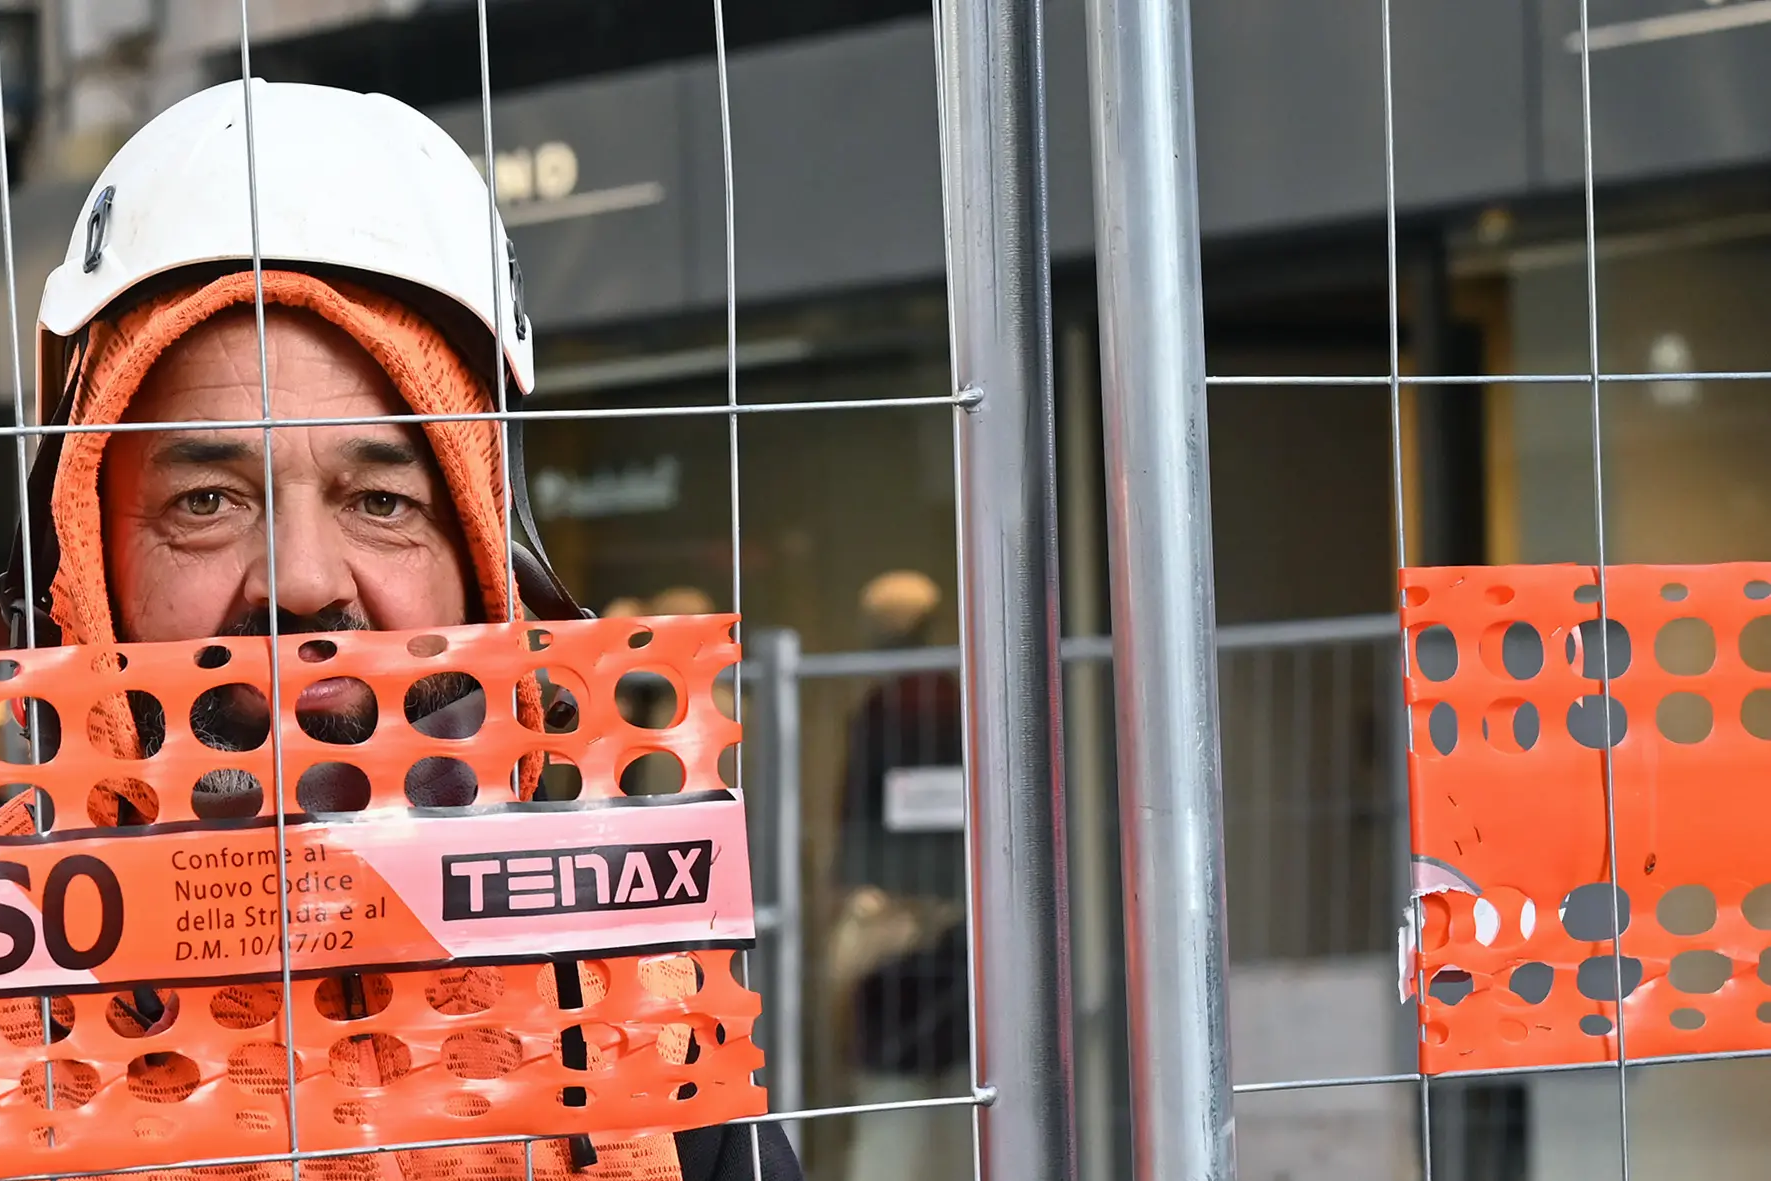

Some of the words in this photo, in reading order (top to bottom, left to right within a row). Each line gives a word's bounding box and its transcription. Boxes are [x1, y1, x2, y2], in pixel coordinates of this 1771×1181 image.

[171, 847, 292, 870] Conforme
[304, 844, 326, 862] al
[175, 880, 252, 901] Nuovo
[451, 848, 700, 912] TENAX
[176, 908, 234, 932] della
[340, 906, 353, 920] e
[365, 897, 385, 918] al
[175, 940, 229, 961] D.M.
